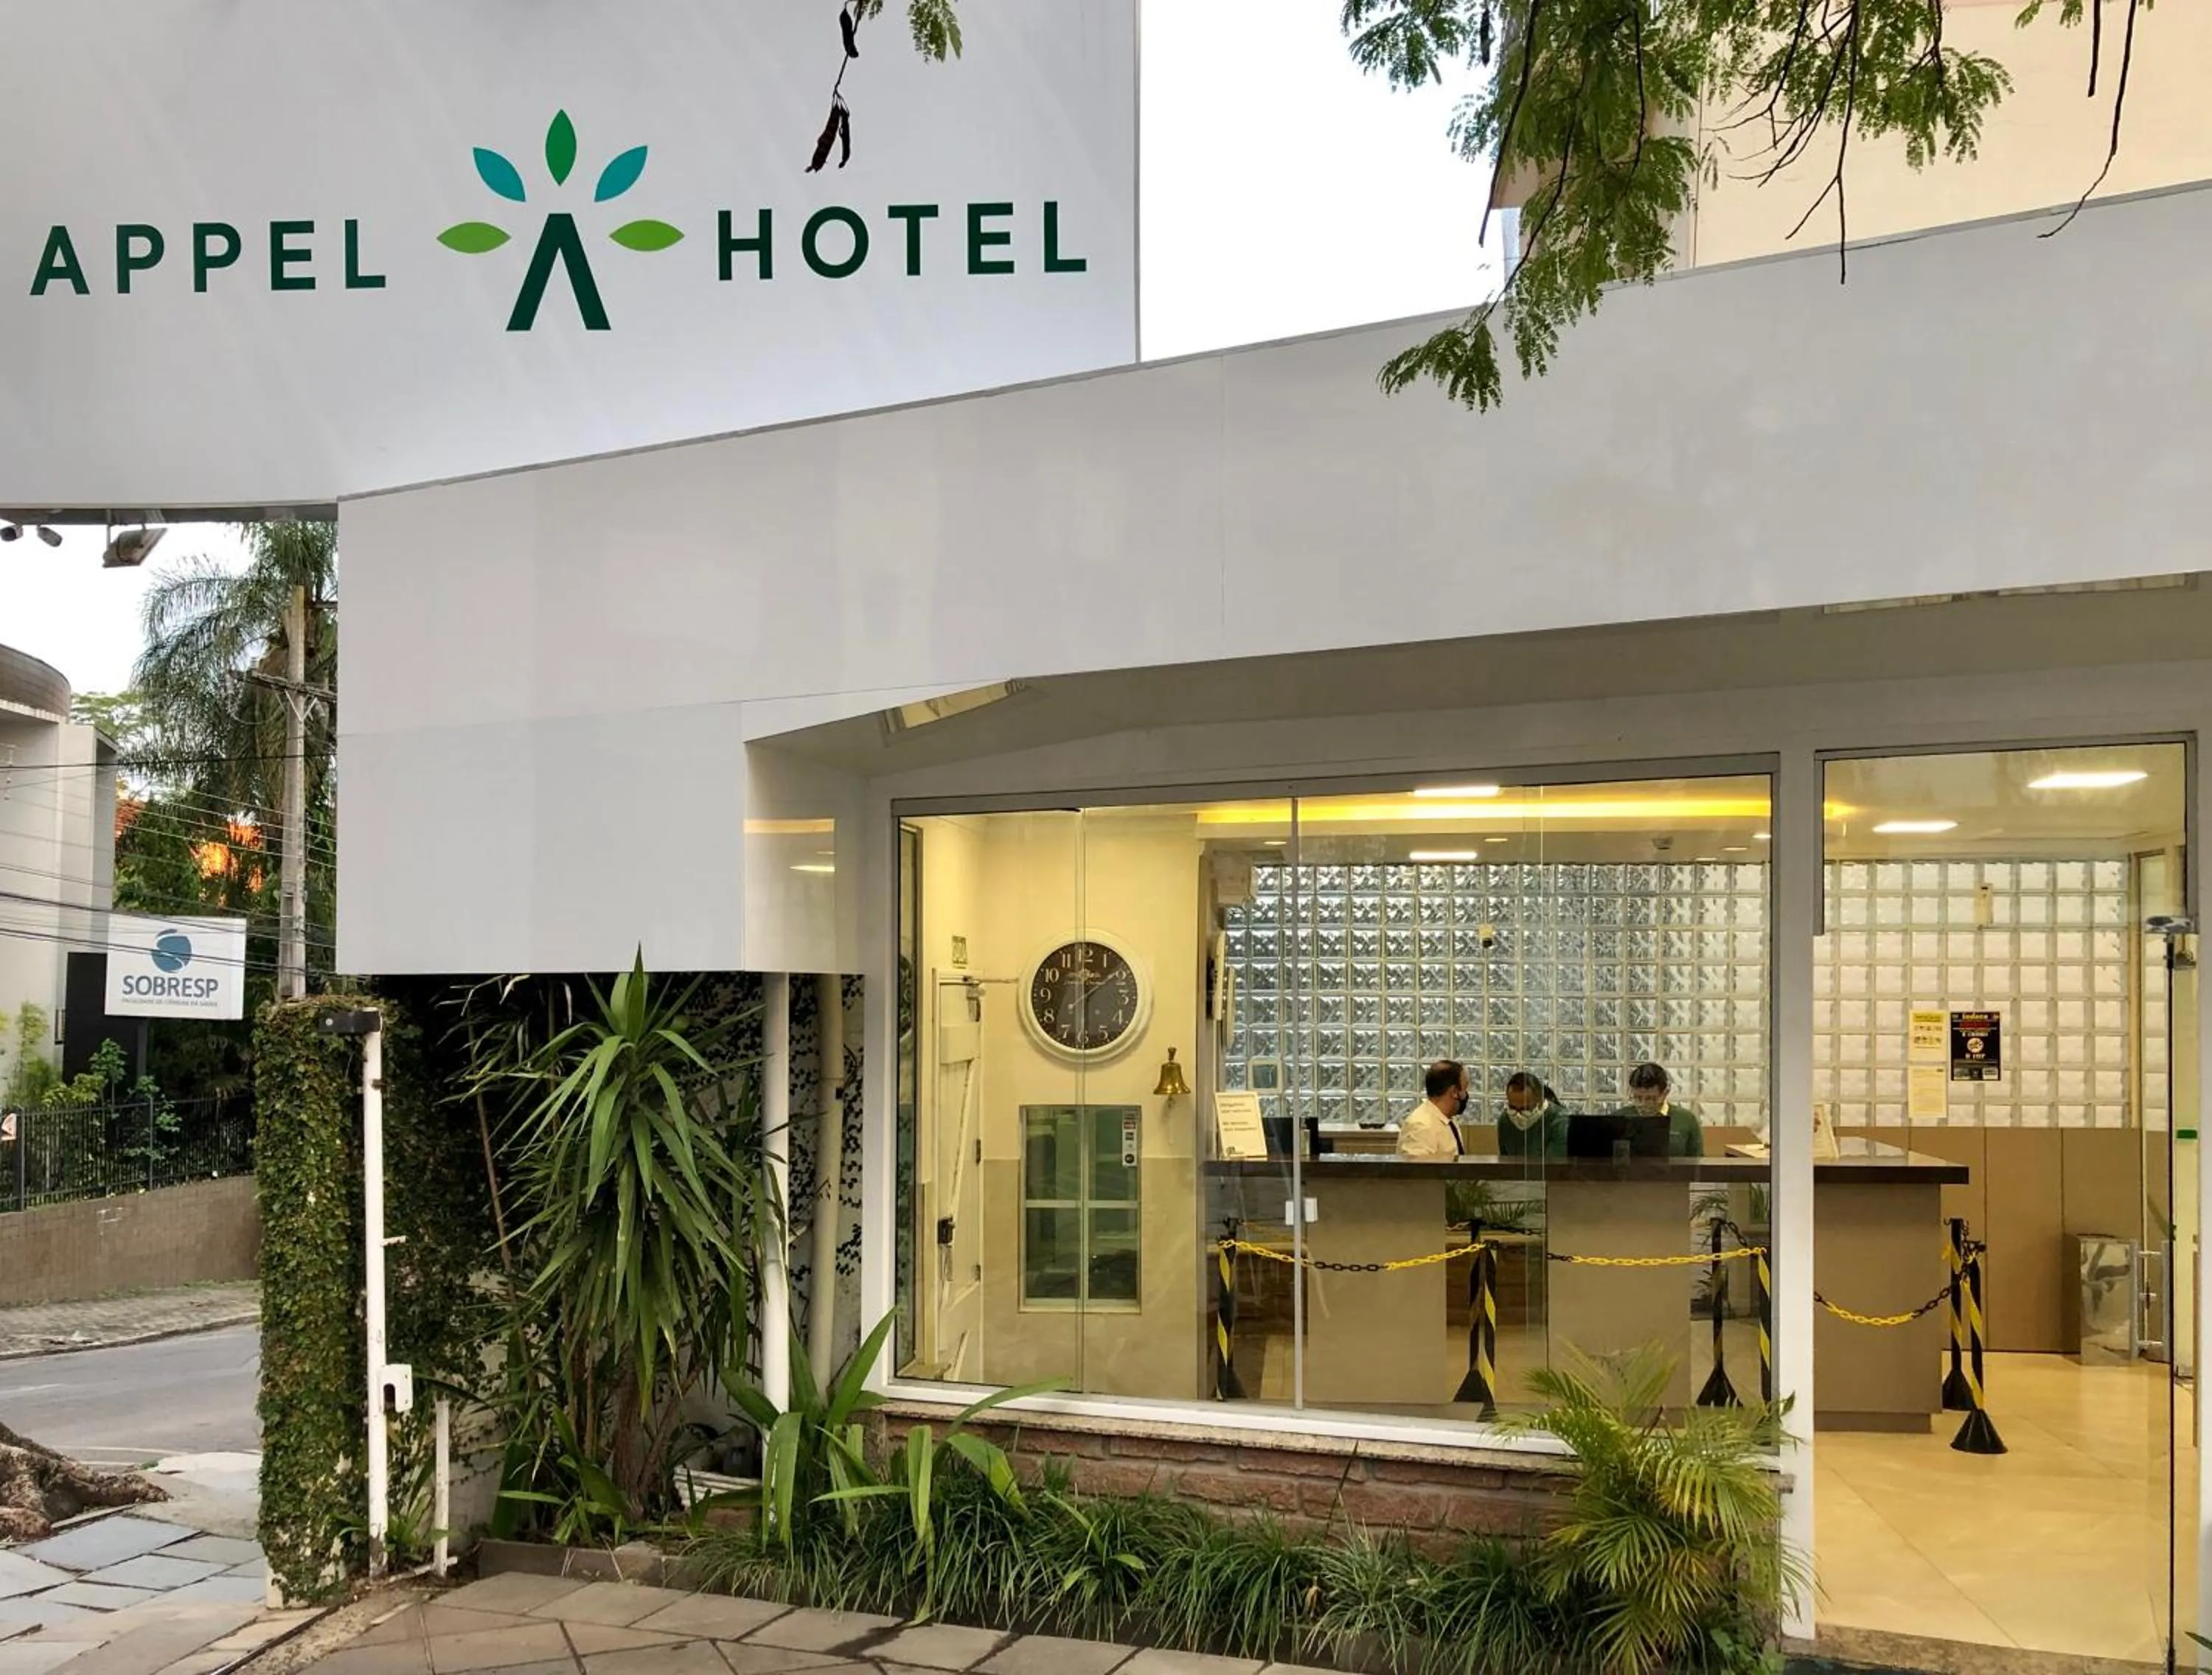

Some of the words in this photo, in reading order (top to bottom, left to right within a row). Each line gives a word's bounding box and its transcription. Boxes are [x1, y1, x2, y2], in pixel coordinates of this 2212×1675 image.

[29, 220, 386, 295] APPEL
[718, 201, 1086, 280] HOTEL
[1062, 953, 1071, 968] 11
[1077, 948, 1093, 963] 12
[1103, 953, 1107, 968] 1
[1044, 967, 1060, 983] 10
[122, 975, 219, 998] SOBRESP
[1040, 987, 1051, 1003] 9
[1118, 989, 1130, 1006] 3
[1043, 1008, 1055, 1024] 8
[1112, 1009, 1124, 1025] 4
[1060, 1024, 1071, 1039] 7
[1077, 1029, 1089, 1044] 6
[1098, 1025, 1108, 1040] 5
